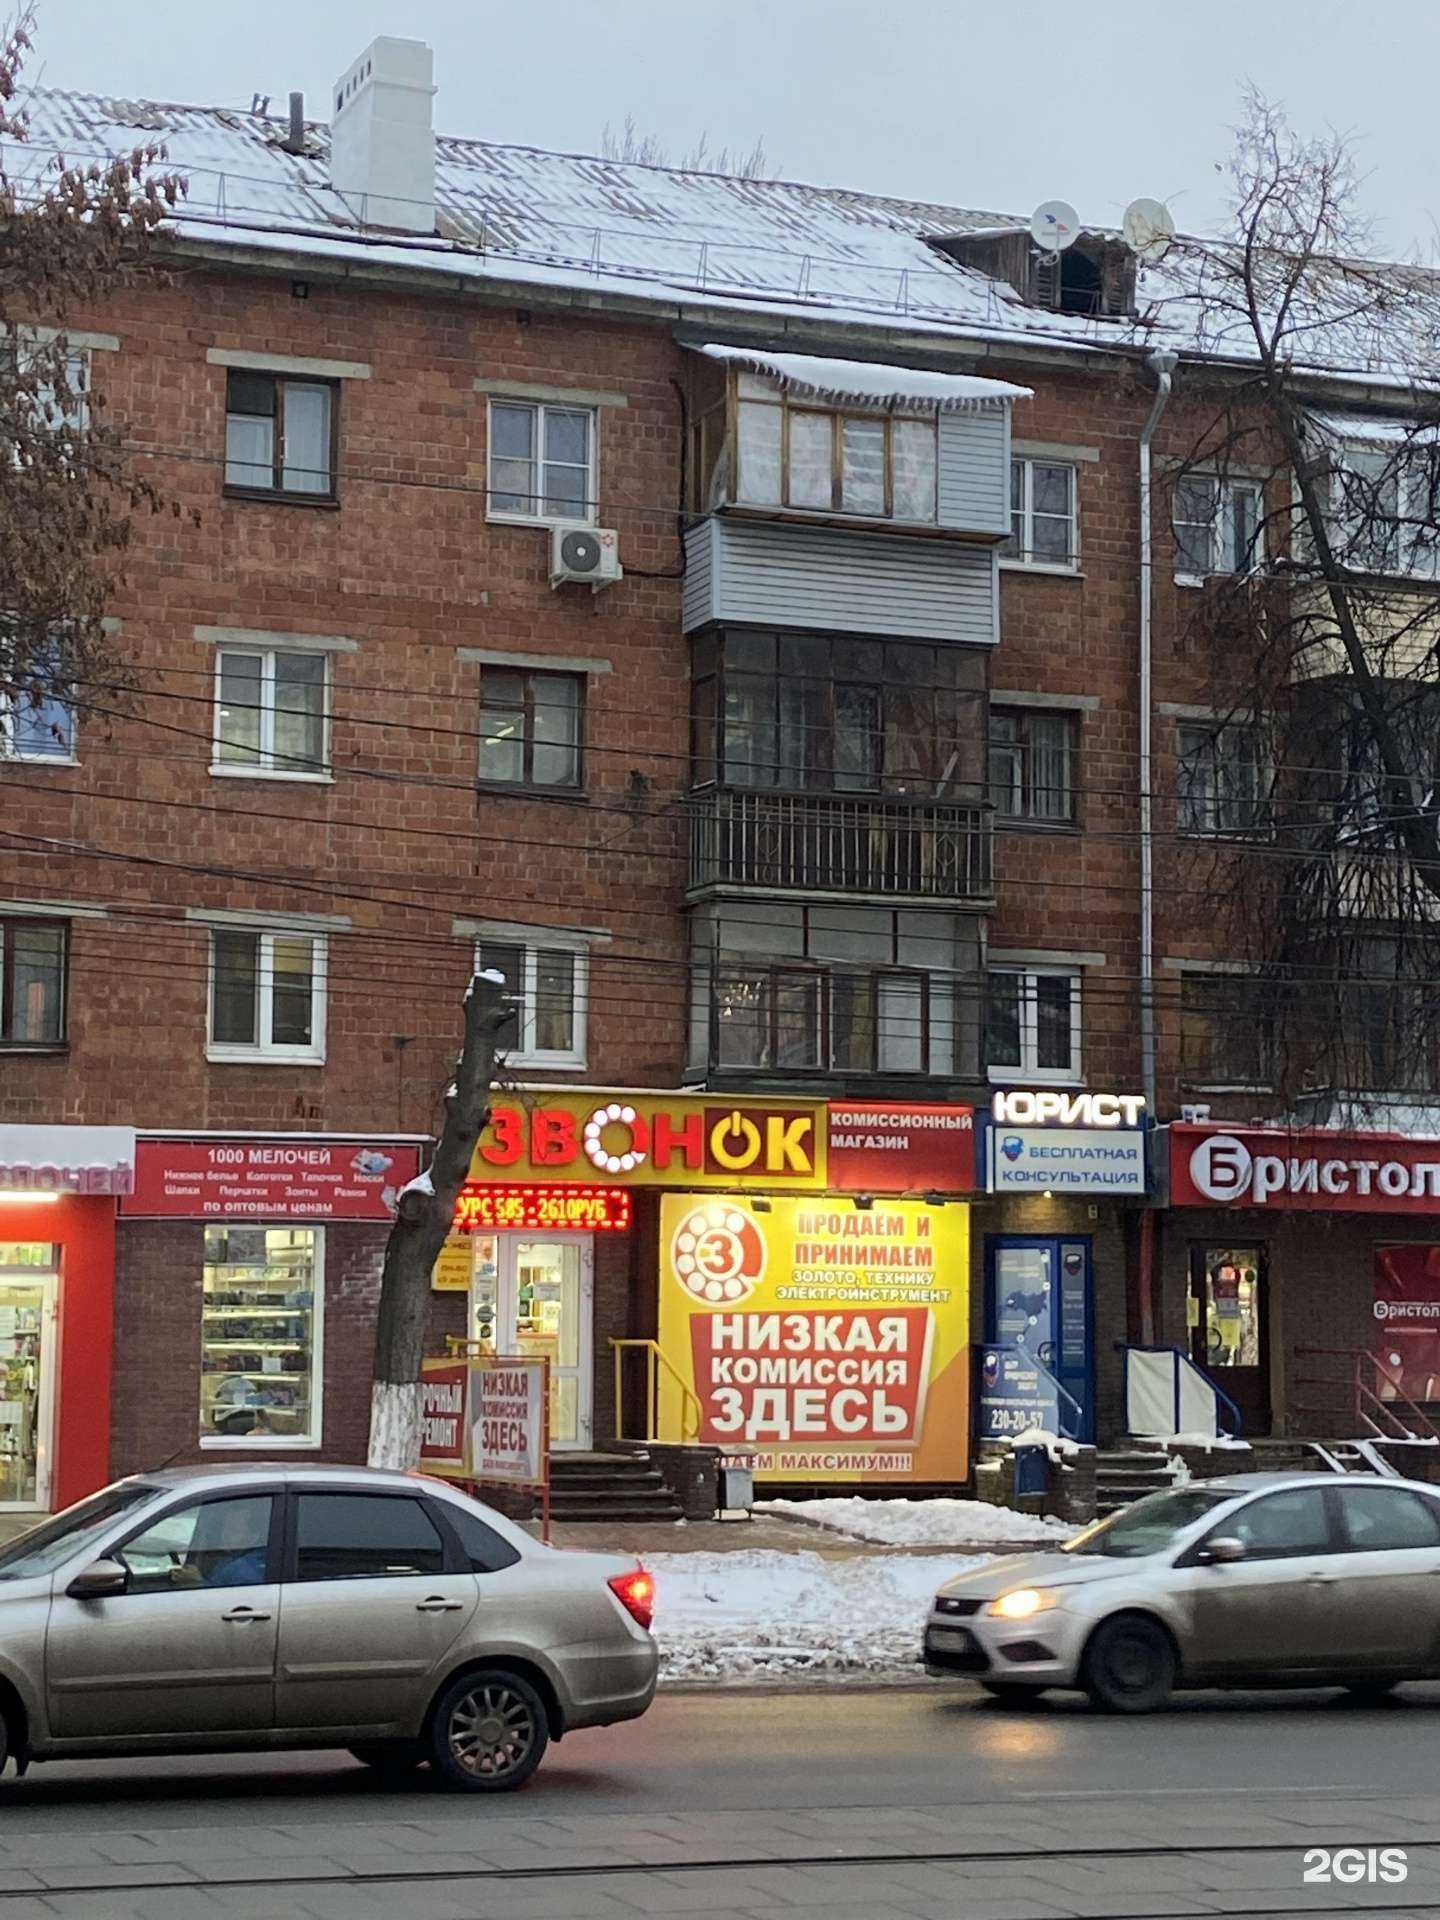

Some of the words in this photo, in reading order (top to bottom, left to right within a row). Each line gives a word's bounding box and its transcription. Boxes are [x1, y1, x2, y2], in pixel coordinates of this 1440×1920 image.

[994, 1091, 1146, 1126] ЮРИСТ
[830, 1111, 973, 1130] КОМИССИОННЫЙ
[478, 1103, 813, 1174] ЗВОНОК
[830, 1133, 910, 1150] МАГАЗИН
[208, 1149, 244, 1164] 1000
[248, 1148, 331, 1164] МЕЛОЧЕЙ
[1029, 1146, 1138, 1160] БЕСПЛАТНАЯ
[1002, 1170, 1139, 1184] КОНСУЛЬТАЦИЯ
[219, 1185, 268, 1196] Перчатки
[285, 1186, 319, 1197] Зонты
[203, 1202, 221, 1212] по
[224, 1202, 287, 1213] оптовым
[290, 1203, 333, 1214] ценам
[457, 1197, 492, 1217] УРС
[495, 1198, 525, 1219] 585
[537, 1199, 607, 1220] 2610РУБ
[798, 1213, 904, 1238] ПРОДАЕМ
[916, 1216, 930, 1236] И
[794, 1243, 933, 1266] ПРИНИМАЕМ
[792, 1270, 861, 1285] ЗОЛОТО,
[865, 1271, 935, 1285] ТЕХНИКУ
[776, 1285, 950, 1302] ЭЛЕКТРОИНСТРУМЕНТ
[711, 1314, 908, 1352] НИЗКАЯ
[711, 1357, 908, 1386] КОМИССИЯ
[420, 1379, 463, 1413] РОЧНЫЙ
[482, 1372, 529, 1397] НИЗКАЯ
[710, 1387, 909, 1441] ЗДЕСЬ
[482, 1420, 528, 1456] ЗДЕСЬ
[780, 1453, 912, 1472] МАКСИМУМ!!!
